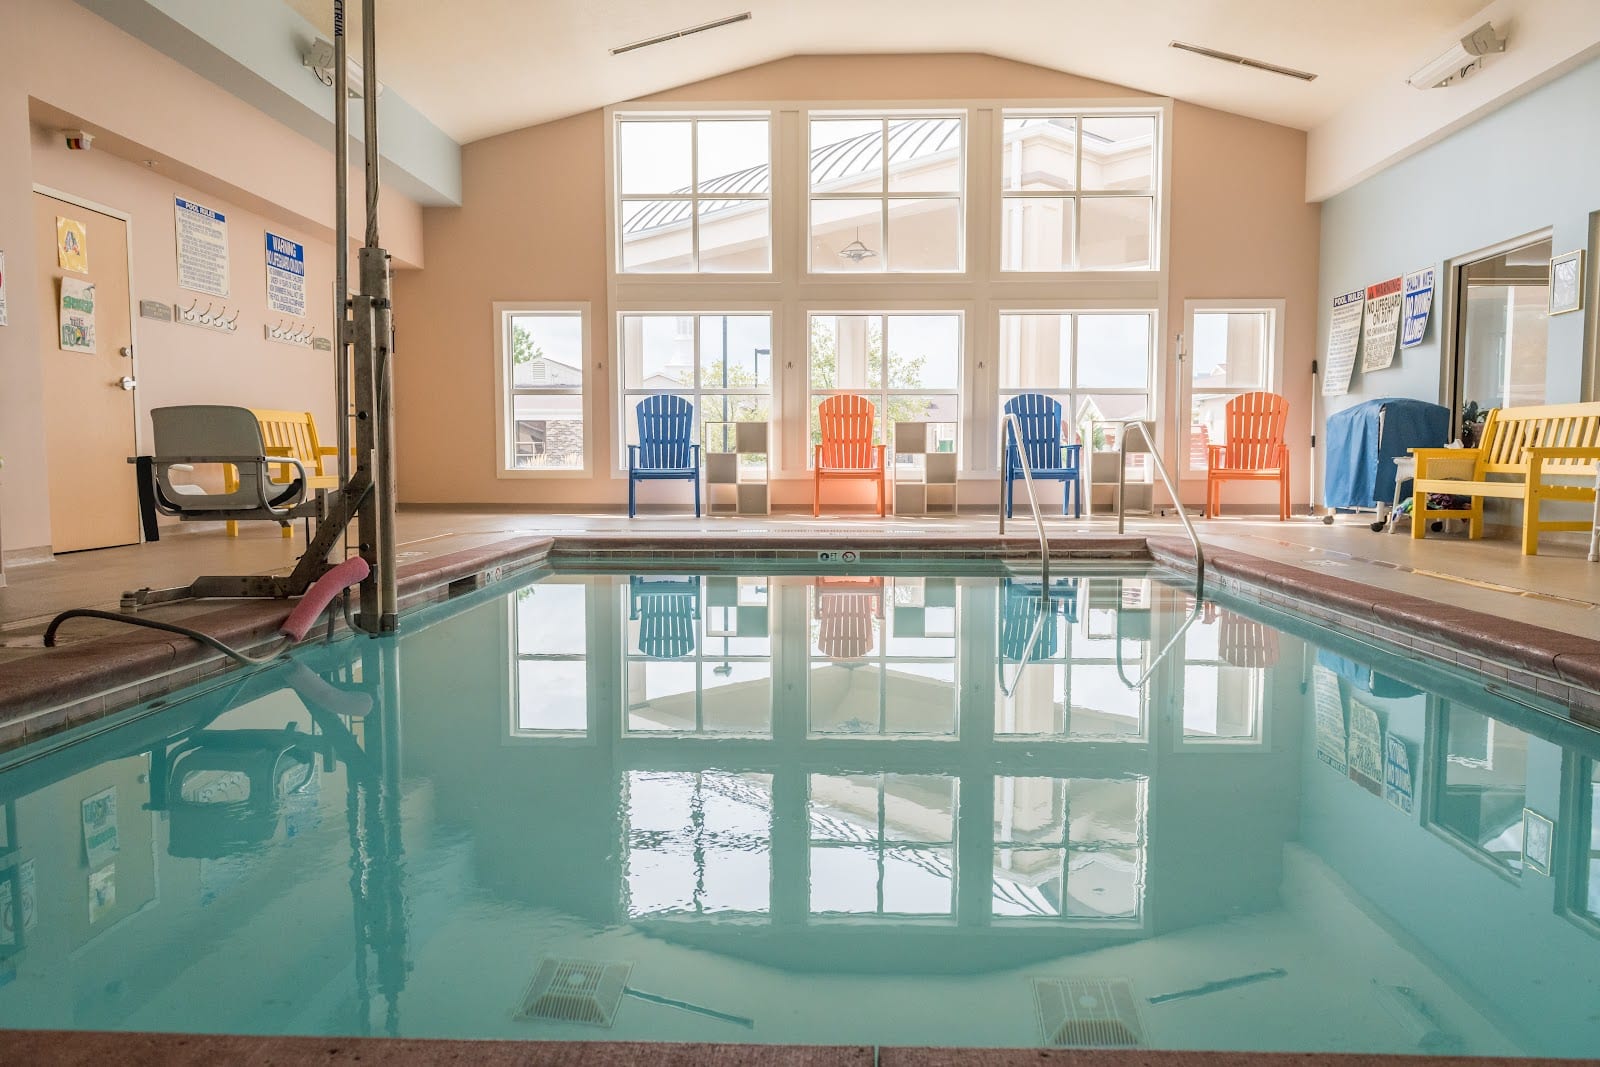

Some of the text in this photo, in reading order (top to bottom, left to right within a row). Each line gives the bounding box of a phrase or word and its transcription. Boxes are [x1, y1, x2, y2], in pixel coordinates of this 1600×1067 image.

[185, 201, 215, 219] POOL RULES
[272, 236, 297, 257] WARNING
[1376, 278, 1401, 296] WARNING
[1334, 290, 1364, 307] POOL RULES
[1367, 294, 1401, 315] NO LIFEGUARD
[1373, 310, 1393, 326] ON DUTY
